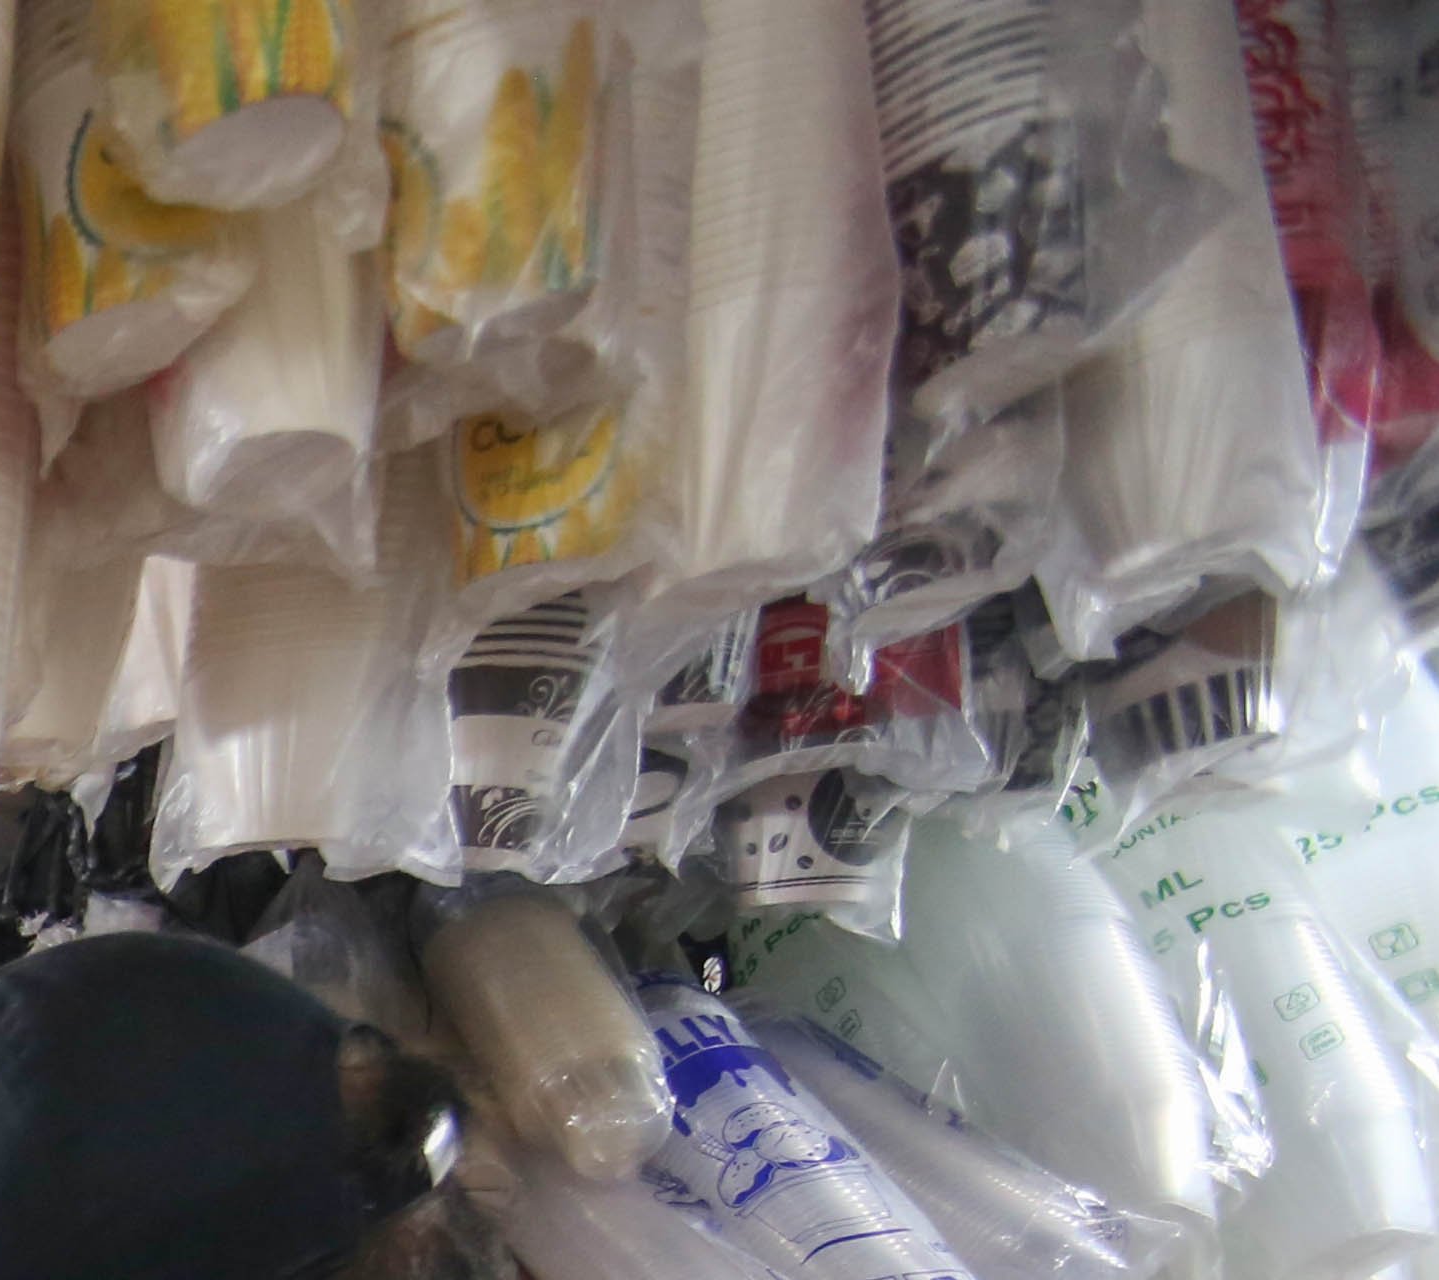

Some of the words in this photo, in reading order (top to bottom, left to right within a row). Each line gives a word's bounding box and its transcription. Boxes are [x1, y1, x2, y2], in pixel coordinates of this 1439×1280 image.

[1137, 869, 1205, 910] ML
[1185, 891, 1272, 935] Pcs
[653, 1013, 740, 1070] LLY
